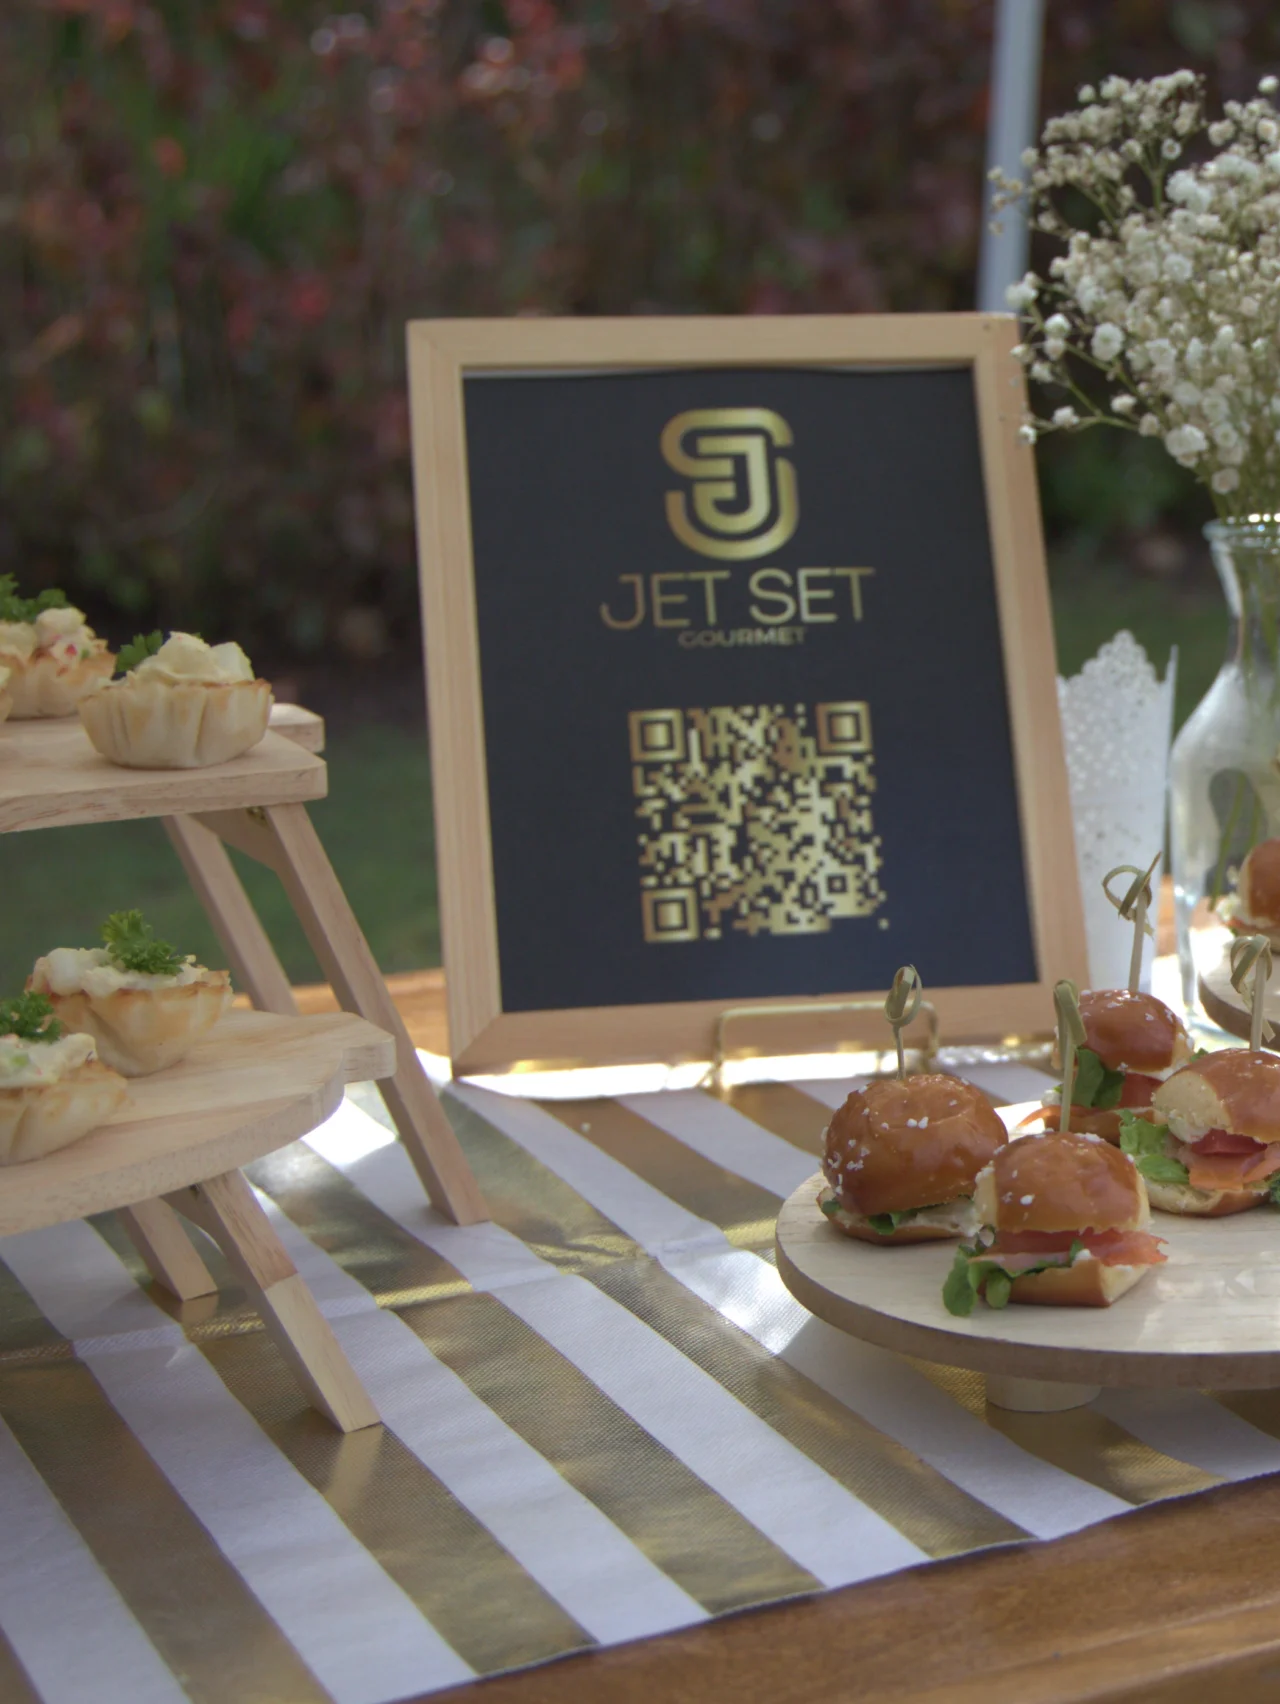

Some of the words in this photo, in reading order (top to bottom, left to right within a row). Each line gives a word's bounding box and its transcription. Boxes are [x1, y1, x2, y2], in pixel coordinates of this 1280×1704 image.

[600, 570, 731, 629] JET
[749, 567, 875, 625] SET
[678, 626, 808, 648] GOURMET
